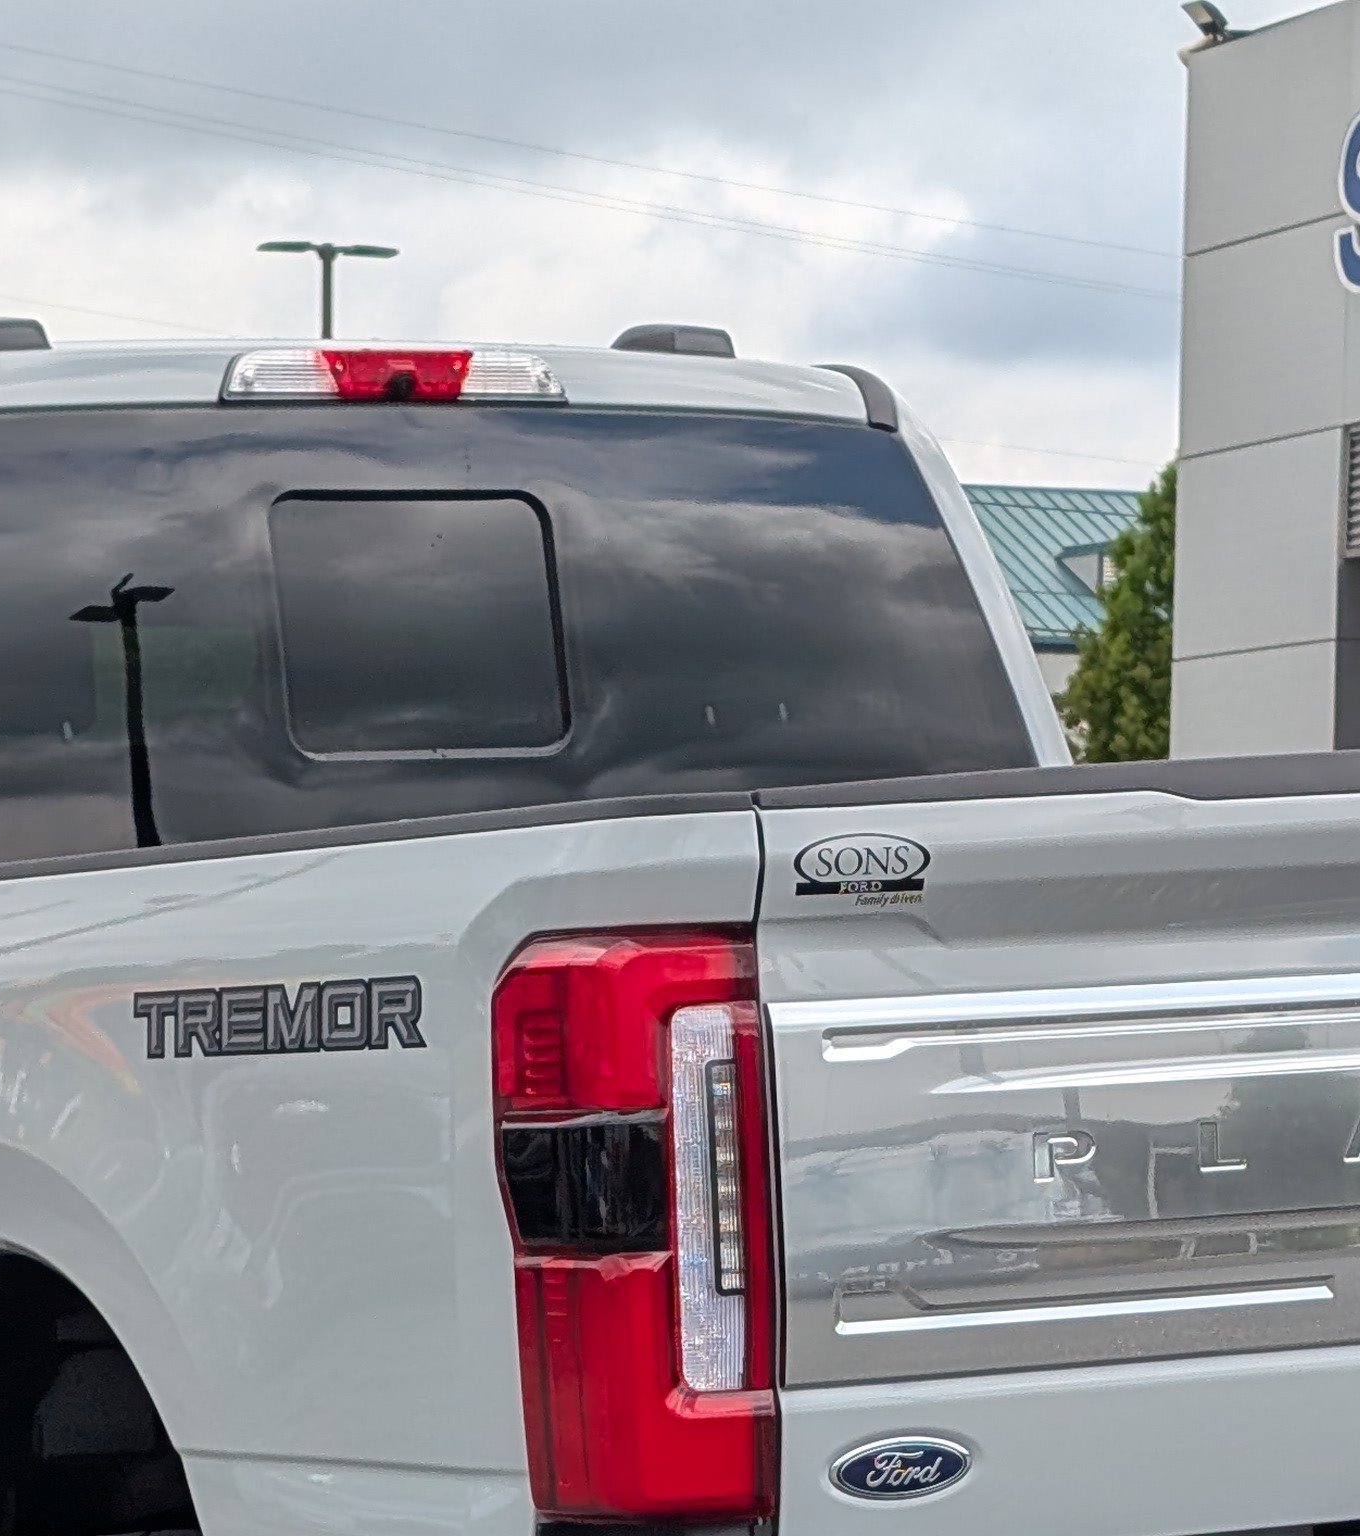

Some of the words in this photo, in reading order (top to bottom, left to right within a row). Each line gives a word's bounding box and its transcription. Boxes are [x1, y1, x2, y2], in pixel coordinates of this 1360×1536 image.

[815, 845, 910, 877] SONS
[839, 880, 883, 894] FORD
[133, 974, 428, 1059] TREMOR
[865, 1450, 944, 1488] Ford
